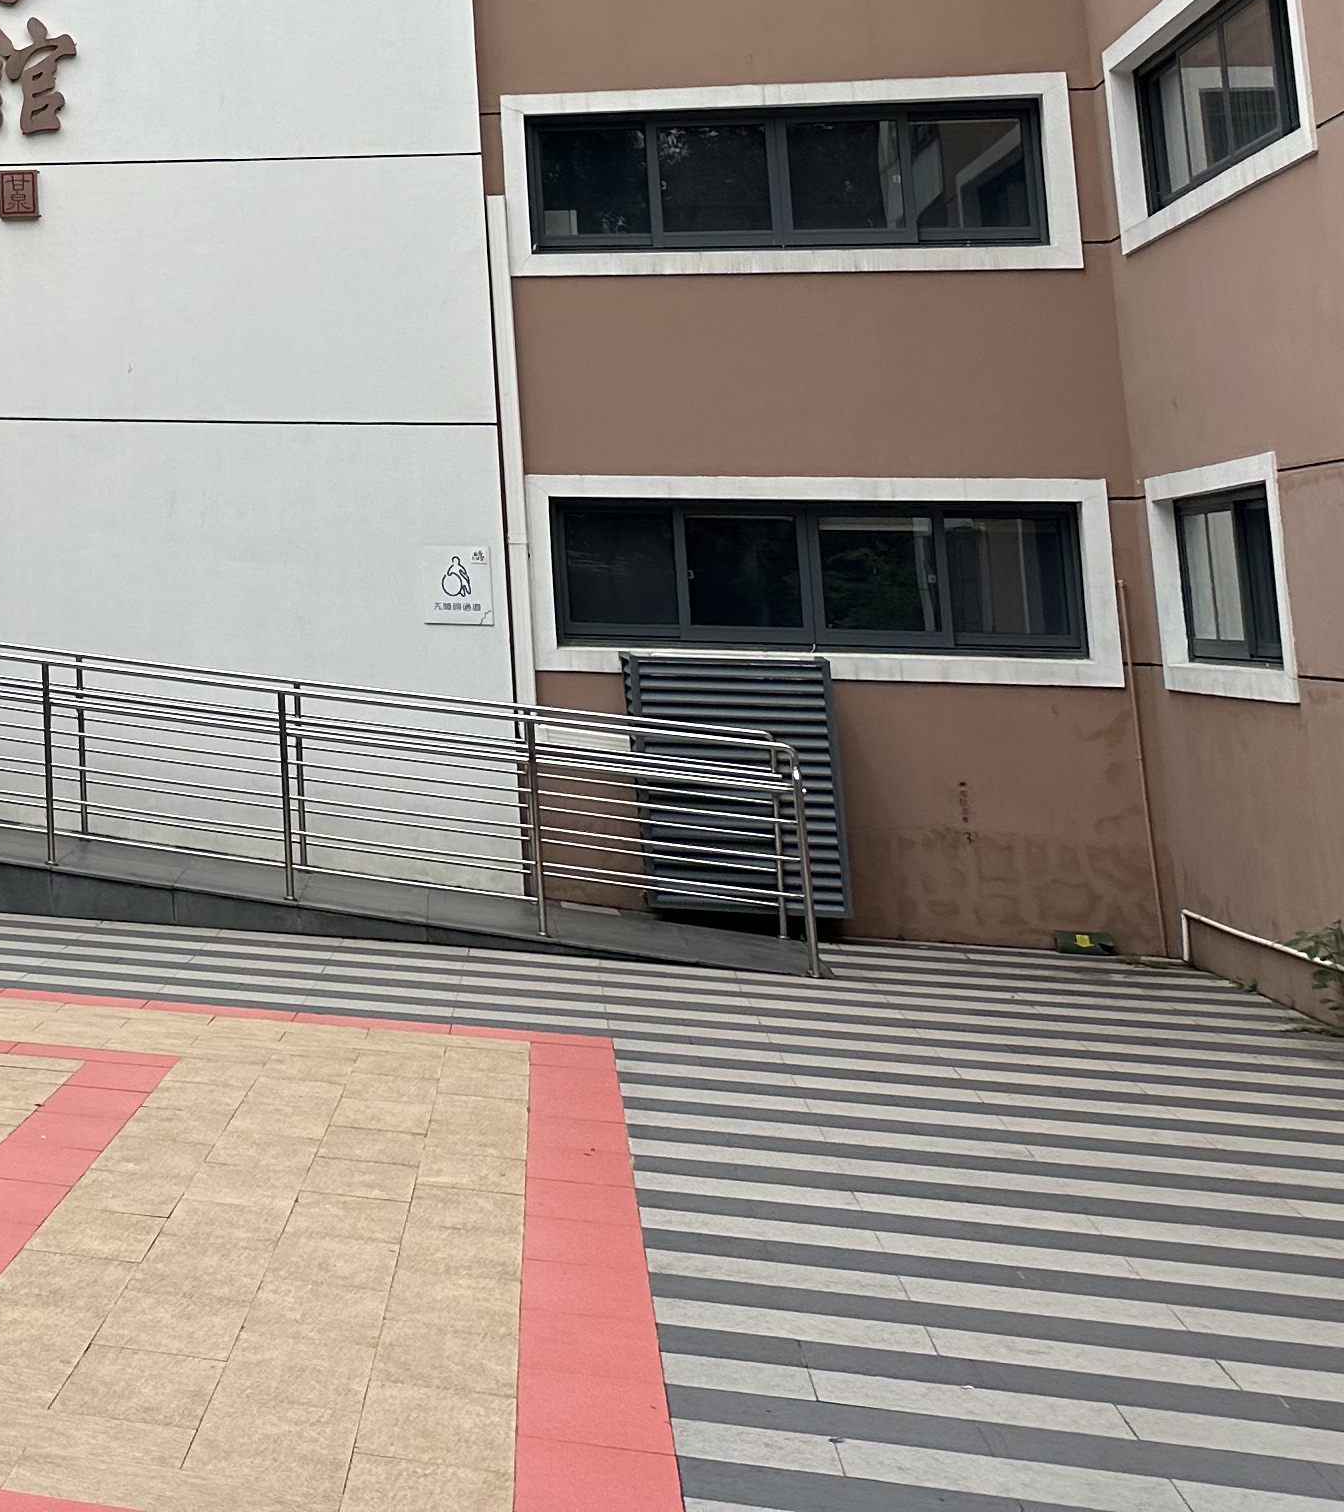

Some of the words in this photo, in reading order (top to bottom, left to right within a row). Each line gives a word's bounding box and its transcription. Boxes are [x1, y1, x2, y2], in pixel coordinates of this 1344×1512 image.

[434, 602, 481, 611] 无障碍通道
